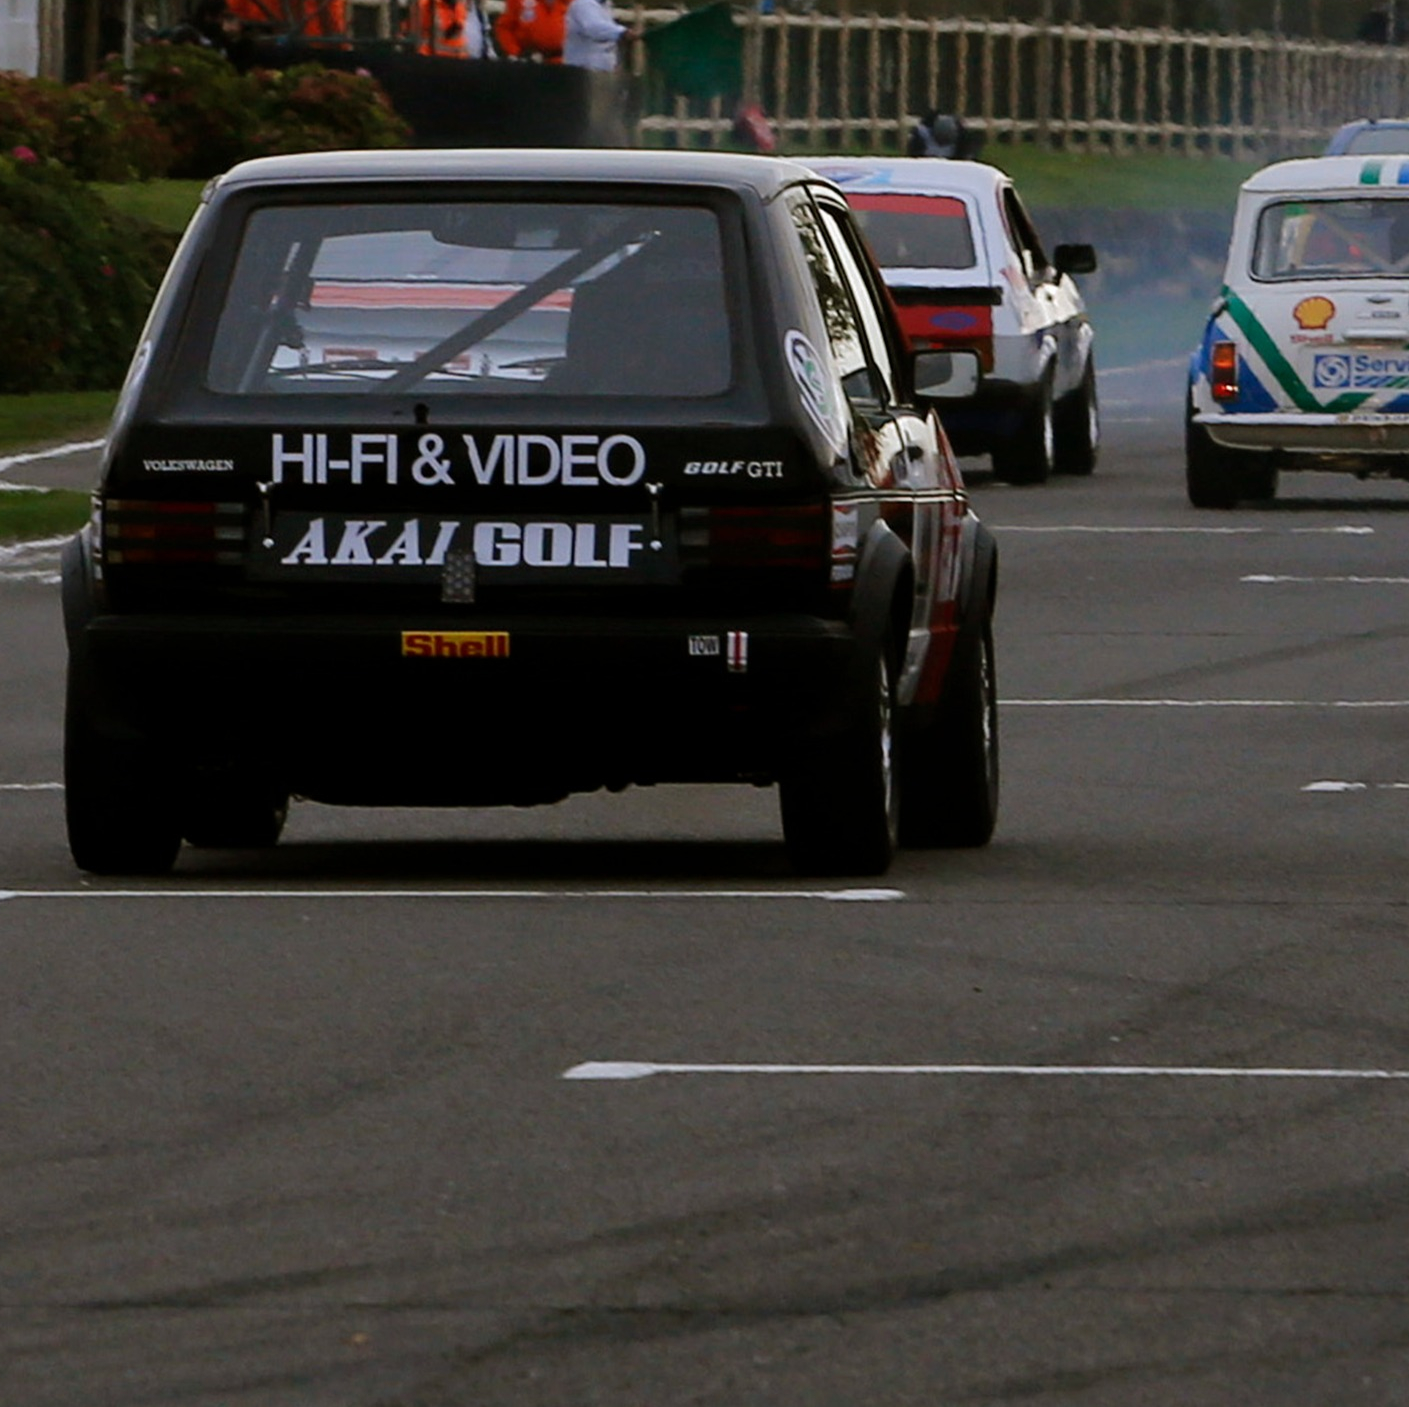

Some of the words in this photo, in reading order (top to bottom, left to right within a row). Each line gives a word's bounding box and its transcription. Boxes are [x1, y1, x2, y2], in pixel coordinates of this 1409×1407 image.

[143, 459, 234, 472] VOLKSWAGEN
[272, 434, 398, 484] HI-FI
[411, 433, 455, 486] &
[462, 434, 646, 486] VIDEO
[684, 461, 745, 475] GOLF
[747, 461, 784, 478] GTI
[281, 518, 460, 565] AKAI
[473, 522, 644, 567] GOLF
[404, 634, 508, 657] Shell
[691, 636, 718, 654] TOW
